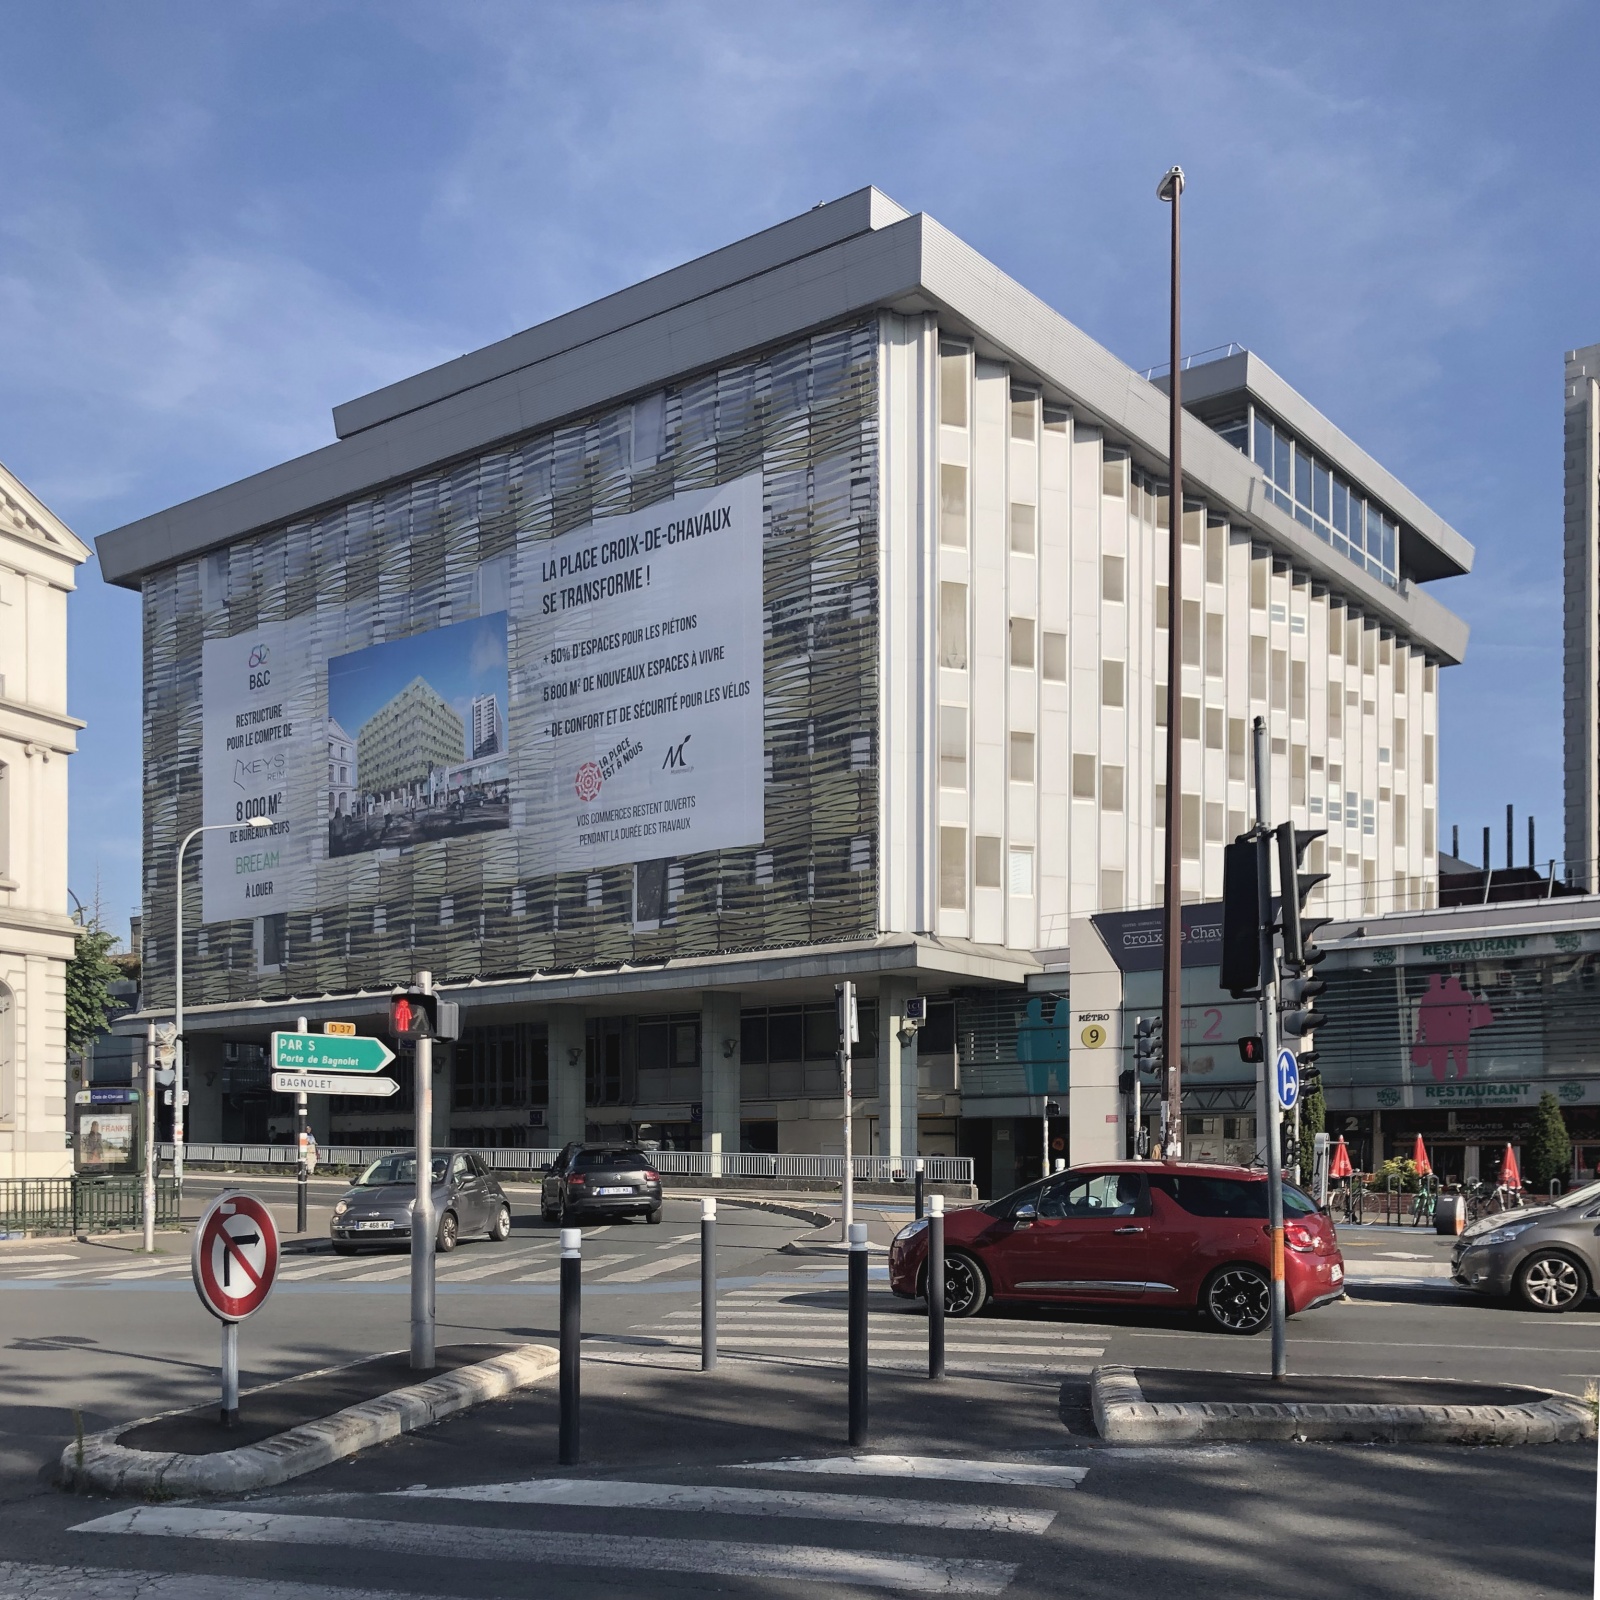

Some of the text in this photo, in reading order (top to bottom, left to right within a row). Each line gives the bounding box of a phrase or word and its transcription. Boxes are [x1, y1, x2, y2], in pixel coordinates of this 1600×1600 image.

[542, 505, 731, 582] LA PLACE CROIX-DE-CHAVAUX
[542, 592, 557, 615] SE
[560, 567, 643, 609] TRANSFORME
[551, 647, 570, 664] 50%
[572, 633, 620, 659] D'ESPACES
[621, 628, 643, 646] POUR
[645, 624, 660, 641] LES
[662, 614, 697, 636] PIÉTONS
[249, 670, 271, 690] B&C
[583, 676, 594, 692] DE
[596, 663, 645, 689] NOUVEAUX
[647, 652, 689, 677] ESPACES
[691, 650, 697, 667] À
[699, 645, 725, 665] VIVRE
[236, 703, 282, 728] RESTRUCTURE
[551, 721, 563, 737] DE
[564, 712, 604, 734] CONFORT
[606, 709, 618, 726] ET
[619, 705, 631, 723] DE
[633, 692, 678, 720] SÉCURITÉ
[680, 691, 702, 709] POUR
[704, 687, 720, 704] LES
[722, 680, 750, 700] VÉLOS
[226, 723, 293, 751] POUR LE COMPTE DE
[242, 753, 285, 775] KEYS
[598, 737, 631, 769] LA PLACE
[602, 741, 643, 781] EST À NOUS
[576, 795, 696, 827] VOS COMMERCES RESTENT OUVERTS
[230, 820, 290, 844] DE BUREAUX NEUFS
[579, 817, 691, 846] PENDANT LA DURÉE DES TRAVAUX
[236, 850, 280, 874] BREEAM
[245, 881, 274, 898] À LOUER
[1122, 931, 1163, 945] Croix
[1422, 937, 1529, 957] RESTAURANT
[331, 1025, 352, 1033] D 37
[1078, 1013, 1110, 1022] MÉTRO
[1202, 1008, 1223, 1040] 2
[279, 1038, 316, 1051] PARS
[1089, 1029, 1099, 1044] 9
[280, 1053, 359, 1068] Porte de Bagnolet
[280, 1078, 332, 1088] BAGNOLET
[1425, 1083, 1531, 1098] RESTAURANT
[101, 1125, 132, 1133] FRANKIE
[1345, 1117, 1359, 1131] 2
